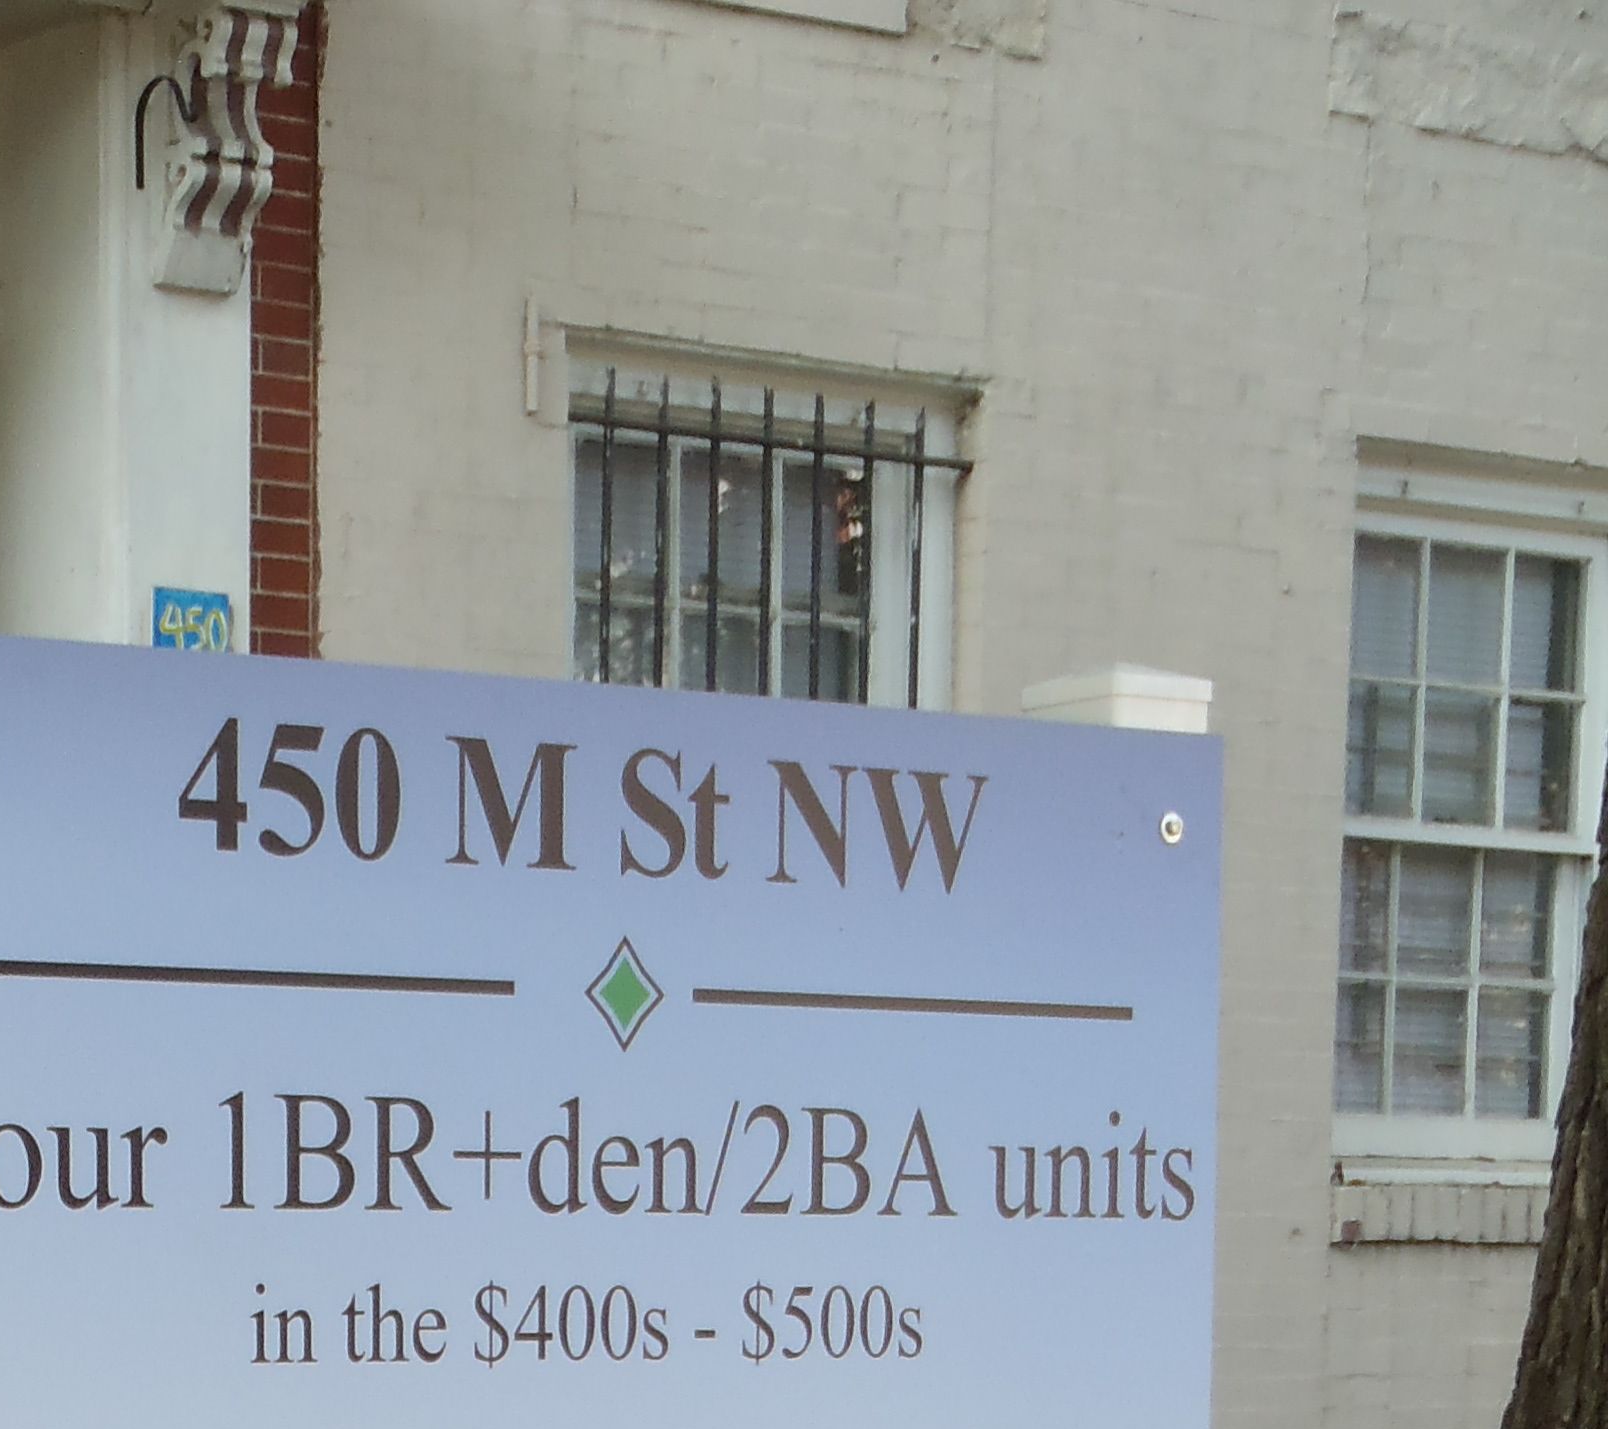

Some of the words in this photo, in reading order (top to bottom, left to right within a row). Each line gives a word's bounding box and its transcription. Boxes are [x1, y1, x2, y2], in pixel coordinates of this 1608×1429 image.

[159, 602, 229, 652] 450
[179, 718, 400, 860] 450
[446, 736, 577, 870] M
[621, 748, 729, 879] St
[766, 760, 988, 894] NW
[219, 1091, 957, 1216] 1BR+den/2BA
[989, 1111, 1194, 1220] units
[251, 1284, 317, 1363] in
[342, 1284, 446, 1362] the
[475, 1280, 668, 1368] $400s
[743, 1281, 922, 1365] $500s
